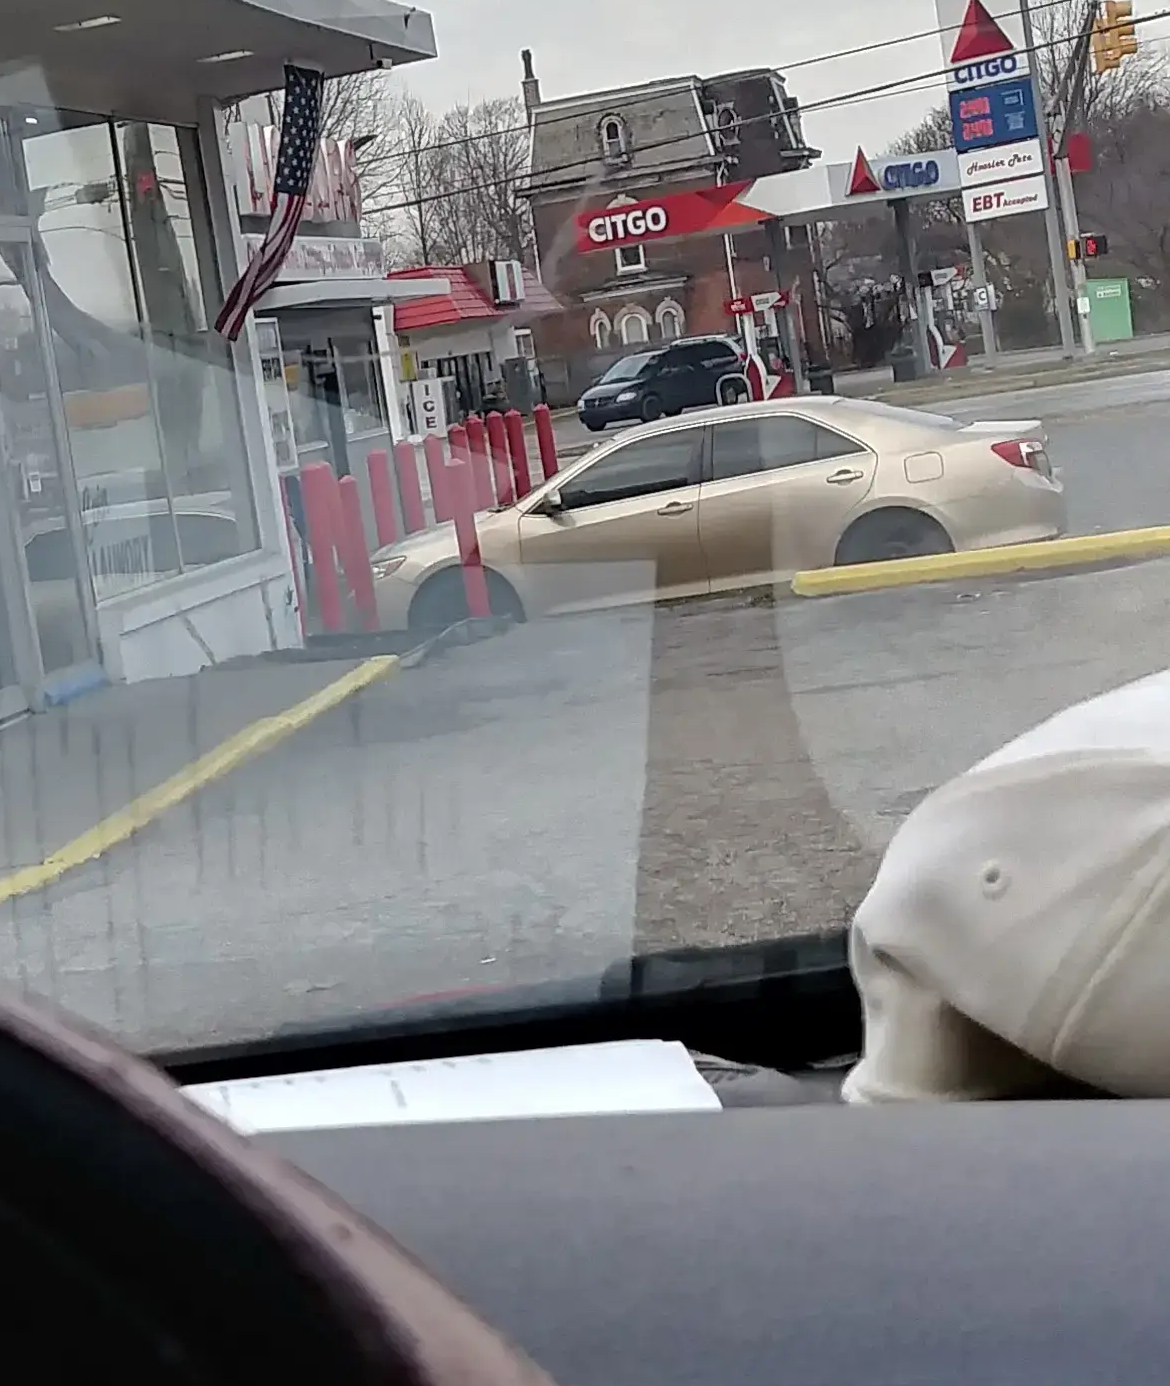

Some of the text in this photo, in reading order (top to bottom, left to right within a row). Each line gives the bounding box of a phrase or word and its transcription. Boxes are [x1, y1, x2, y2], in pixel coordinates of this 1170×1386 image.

[954, 55, 1017, 84] CITGO
[883, 160, 941, 190] CITGO
[972, 191, 1005, 214] EBT
[587, 205, 667, 243] CITGO
[422, 384, 437, 430] ICE
